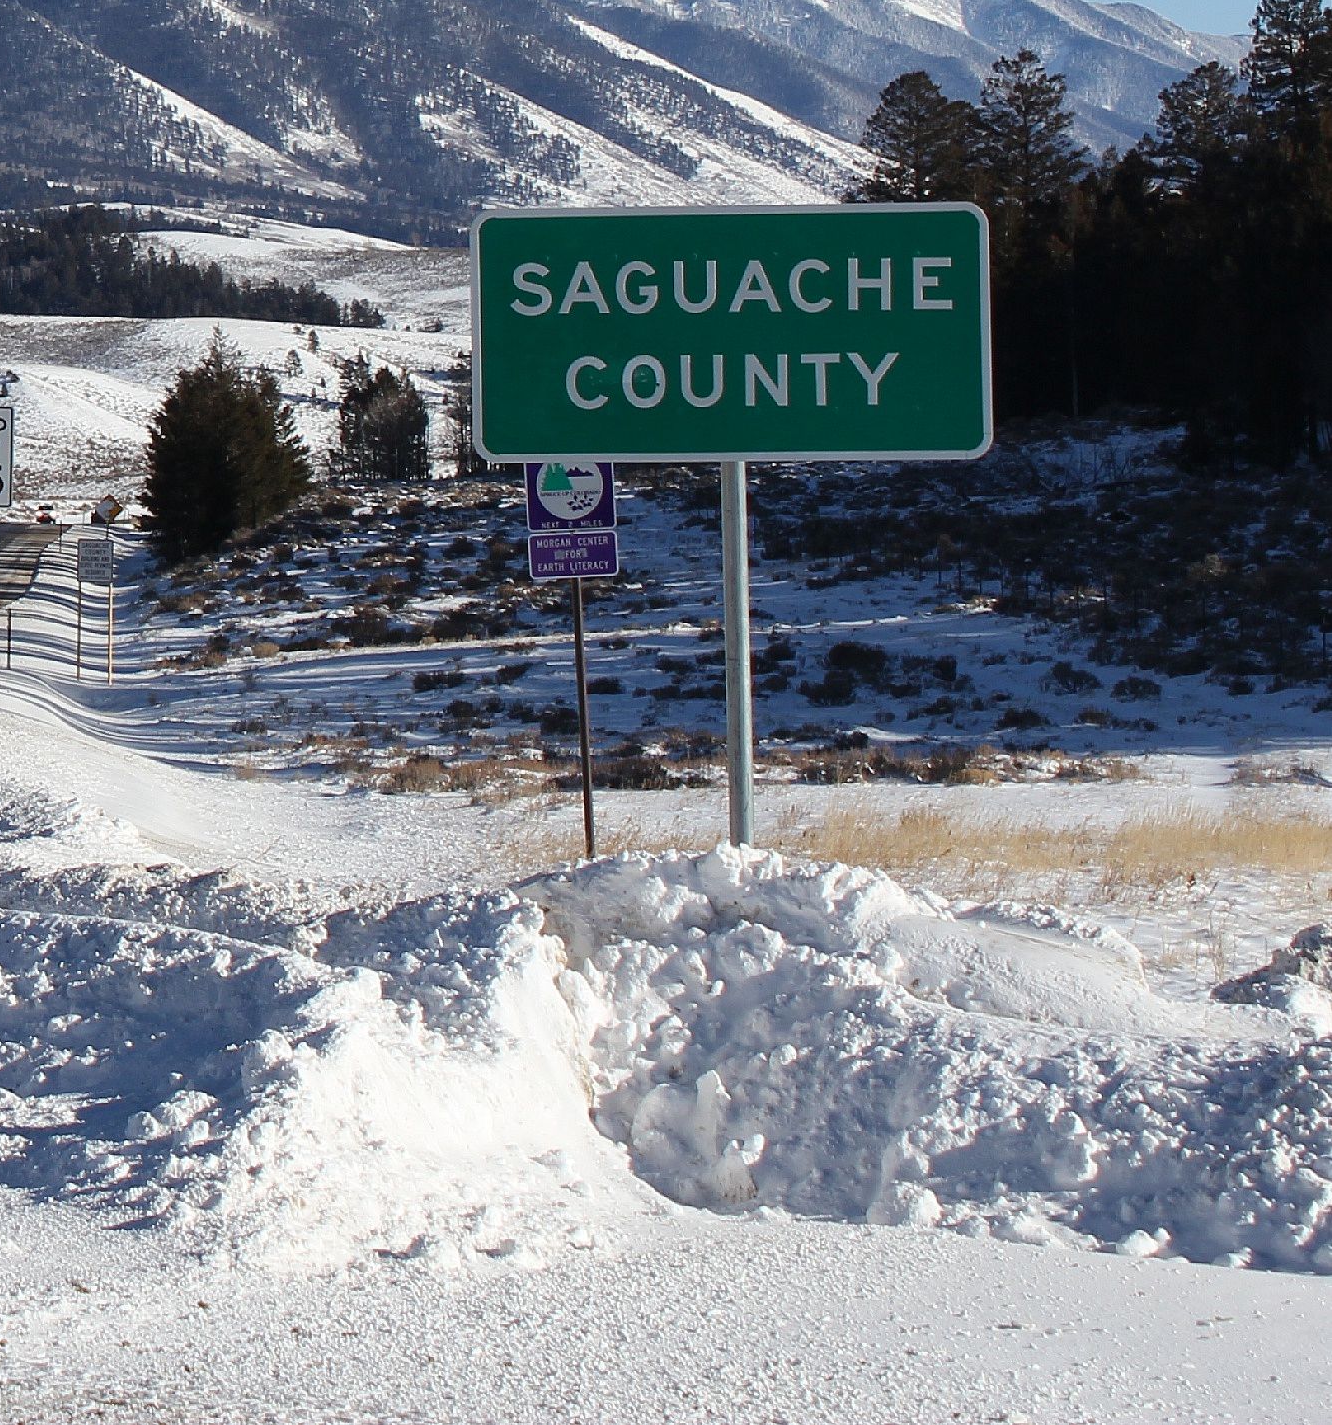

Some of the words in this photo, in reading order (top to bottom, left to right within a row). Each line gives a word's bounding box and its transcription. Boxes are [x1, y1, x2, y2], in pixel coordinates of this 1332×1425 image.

[510, 257, 953, 316] SAGUACHE
[565, 352, 899, 410] COUNTY
[541, 521, 560, 529] NEXT
[580, 519, 604, 528] MILES
[536, 538, 572, 549] MORGAN
[577, 536, 609, 547] CENTER
[565, 549, 581, 559] FOR
[537, 561, 565, 572] EARTH
[569, 560, 609, 572] LITERACY
